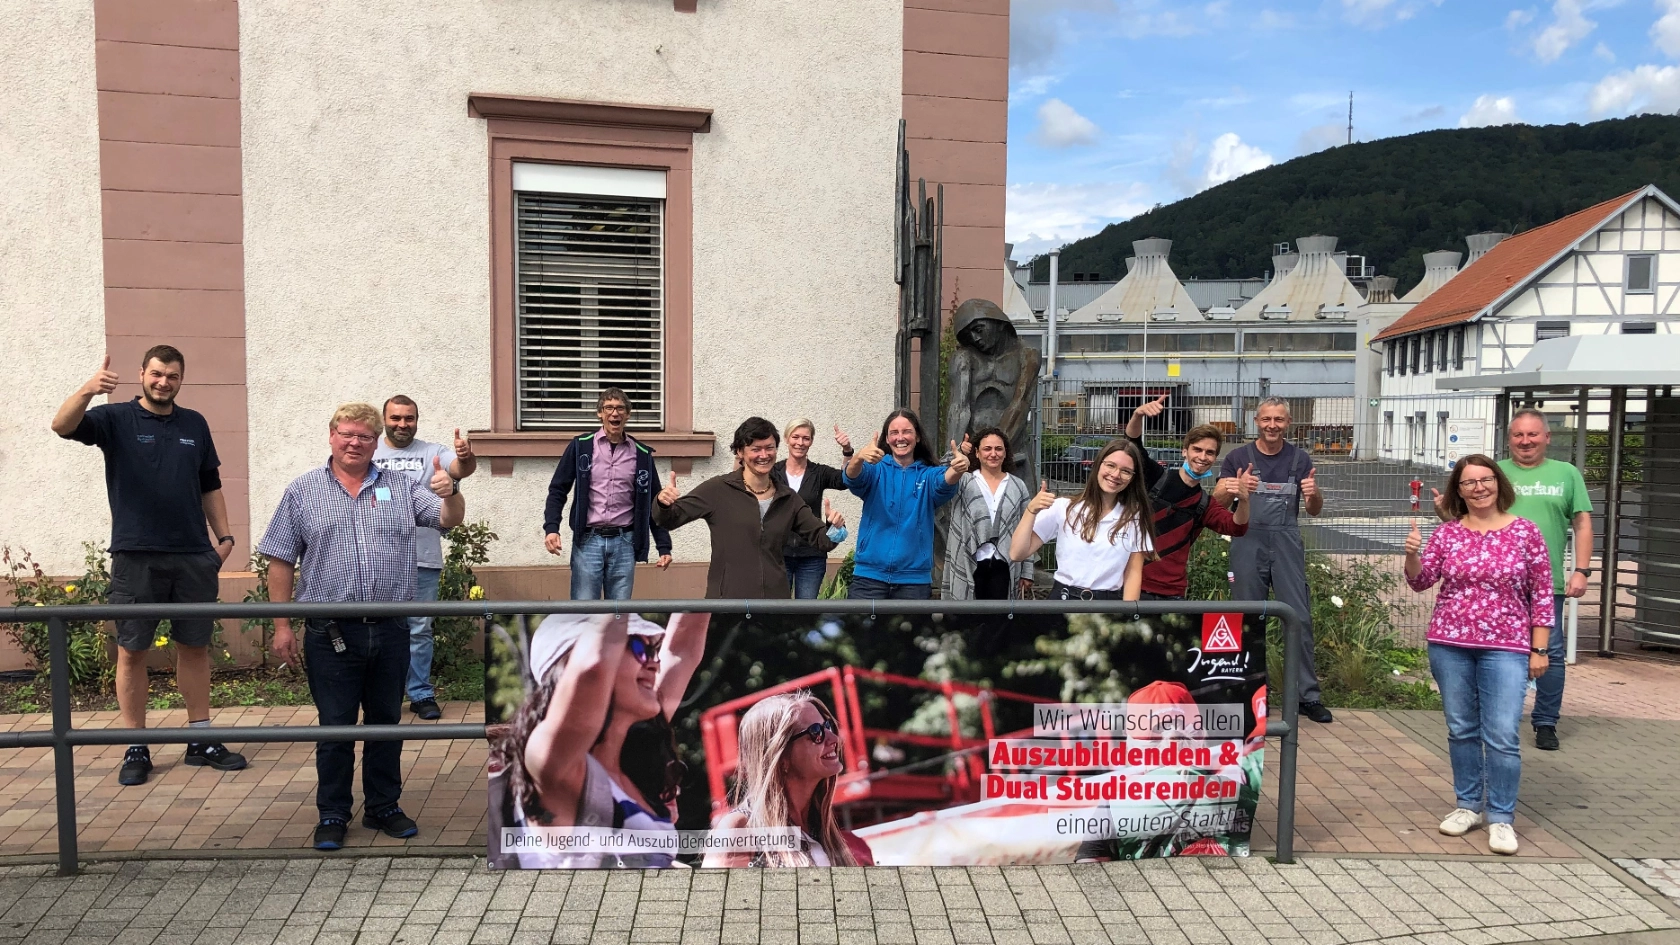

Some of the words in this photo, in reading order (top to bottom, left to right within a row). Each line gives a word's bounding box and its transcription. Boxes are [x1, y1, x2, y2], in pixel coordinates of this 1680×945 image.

[1039, 709, 1073, 730] Wir
[1080, 709, 1185, 730] Wünschen
[1193, 709, 1240, 730] allen
[992, 741, 1211, 766] Auszubildenden
[1219, 741, 1240, 766] &
[986, 775, 1048, 800] Dual
[1056, 775, 1237, 800] Studierenden
[1056, 814, 1110, 835] einen
[1116, 814, 1173, 837] guten
[1179, 807, 1232, 830] Start!
[505, 833, 543, 847] Deine
[545, 832, 595, 850] Jugend-
[599, 833, 624, 847] und
[627, 833, 796, 849] Auszubildendenvertretung
